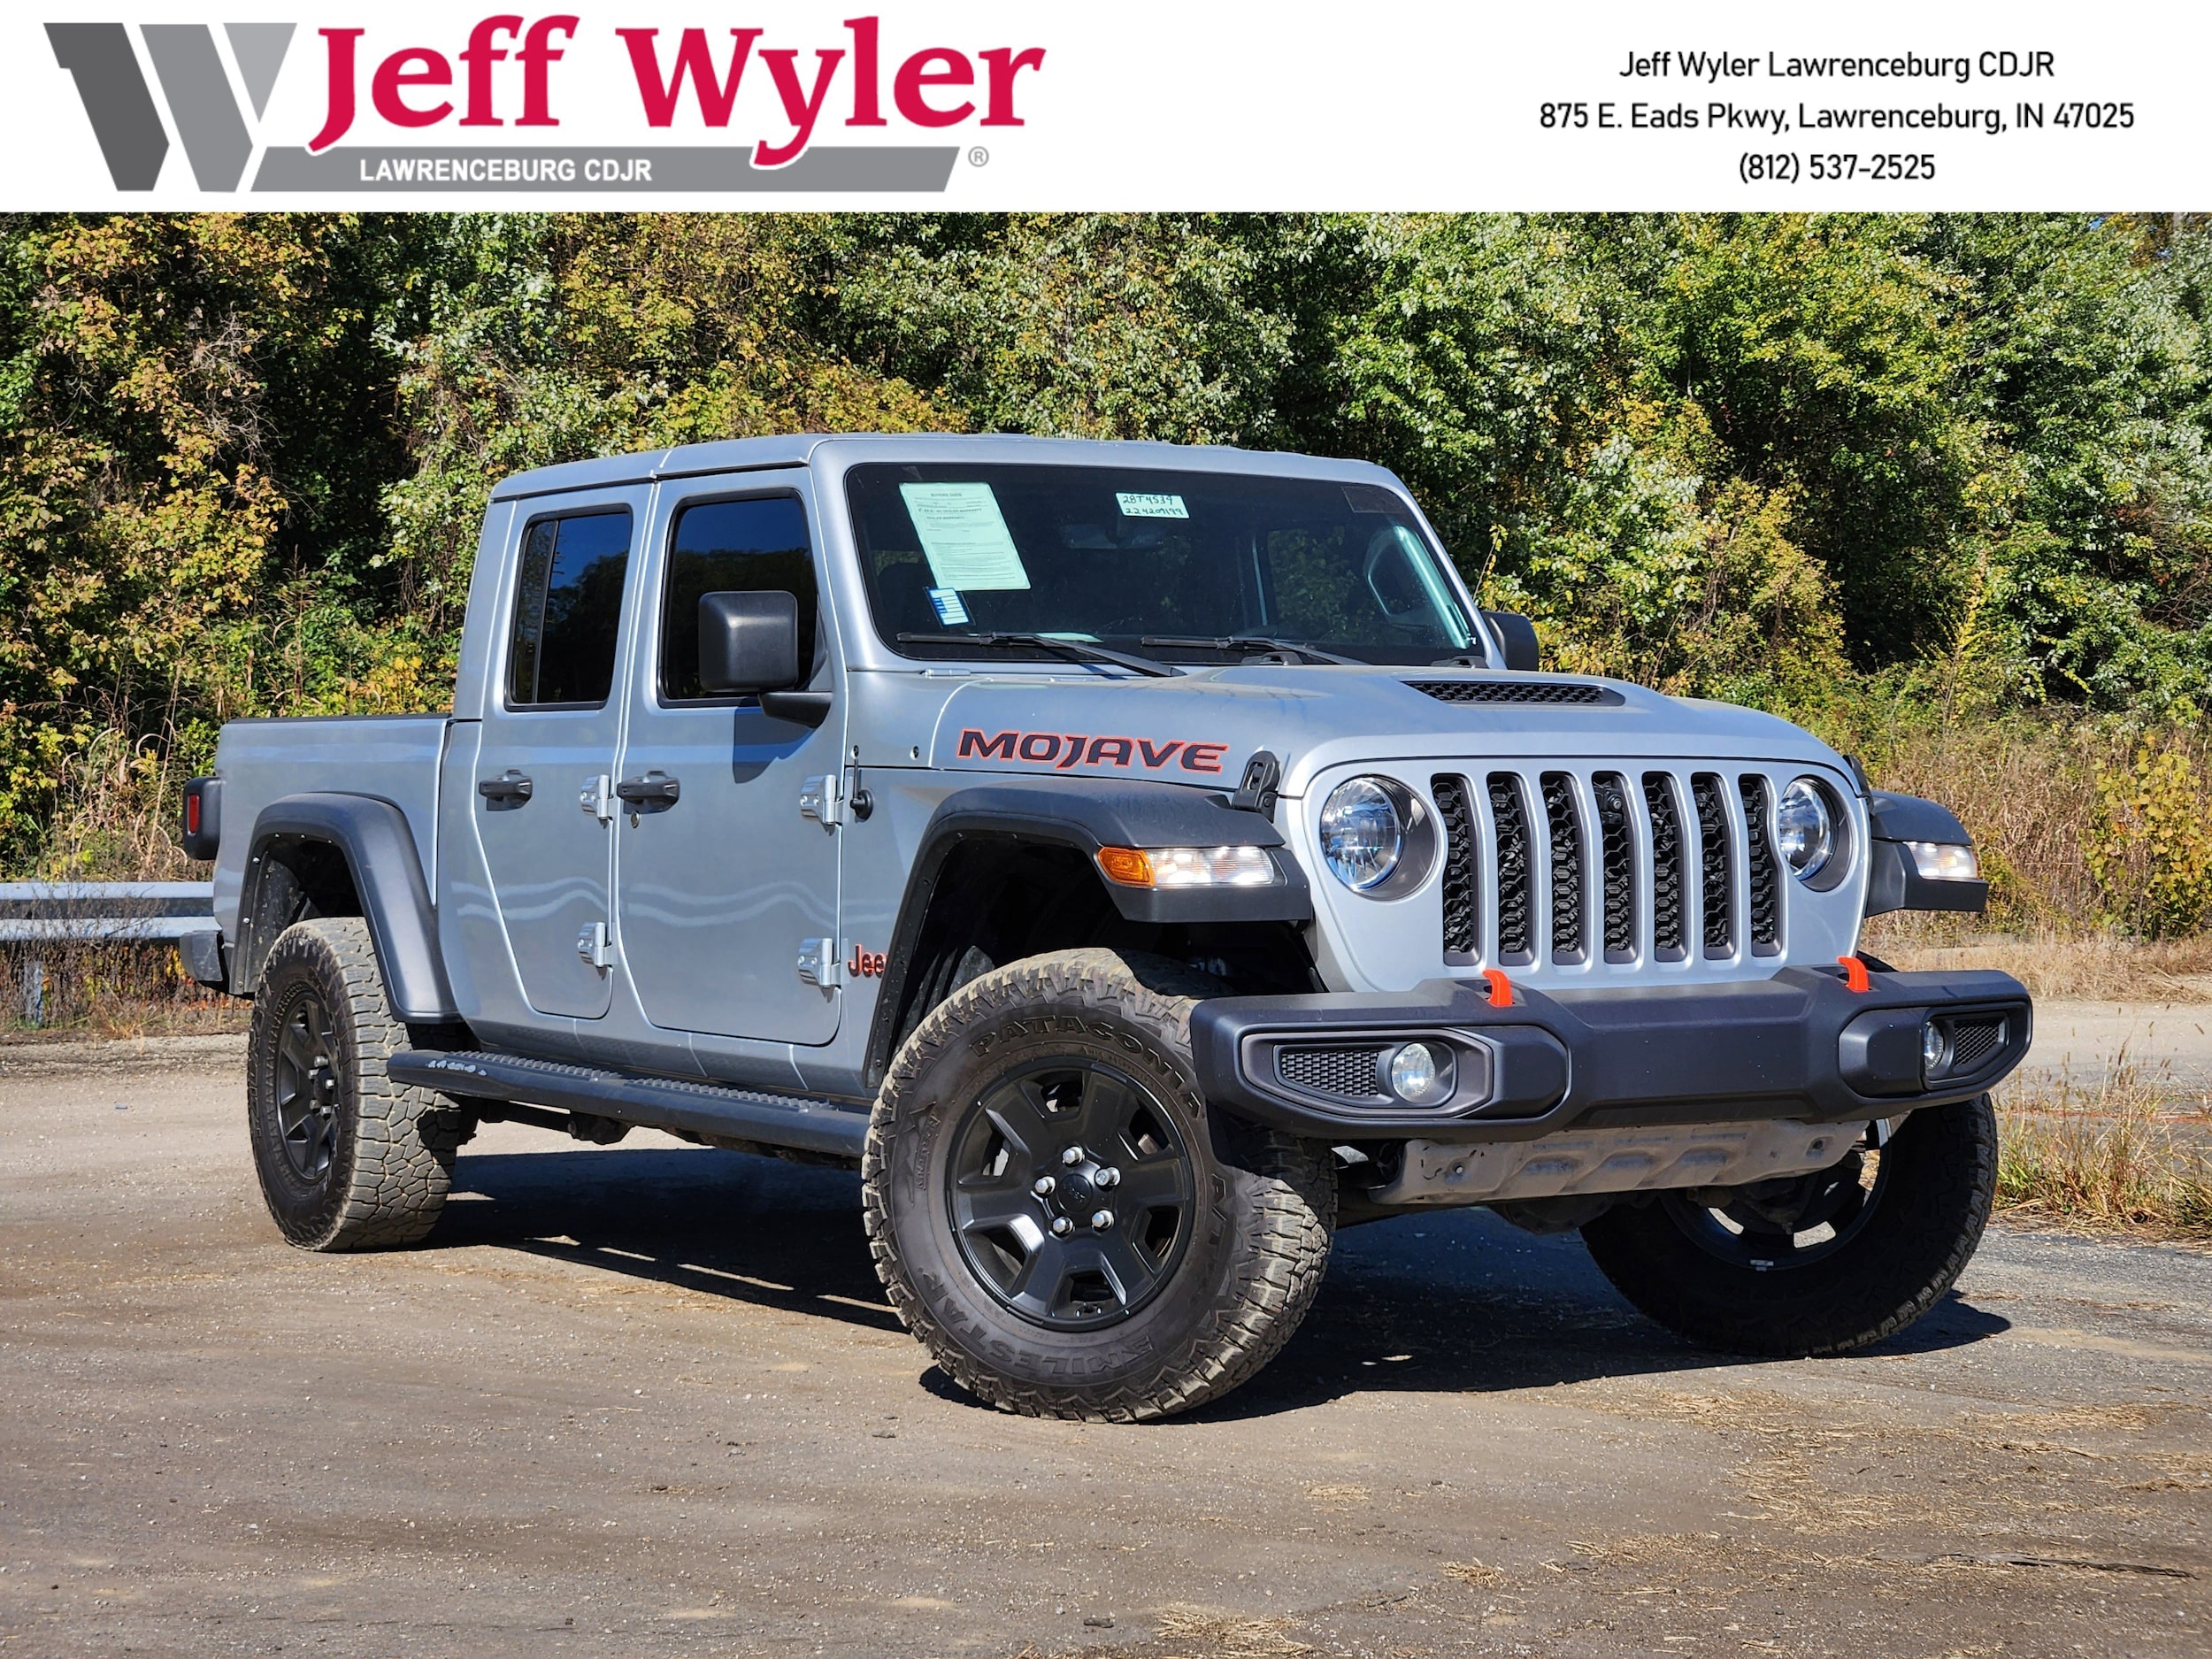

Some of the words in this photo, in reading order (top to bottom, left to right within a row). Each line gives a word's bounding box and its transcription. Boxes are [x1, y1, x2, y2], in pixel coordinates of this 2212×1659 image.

[956, 728, 1230, 774] MOJAVE
[848, 943, 887, 979] Jee
[969, 1014, 1206, 1120] PATAGONIA
[921, 1271, 1125, 1376] MILESTAR
